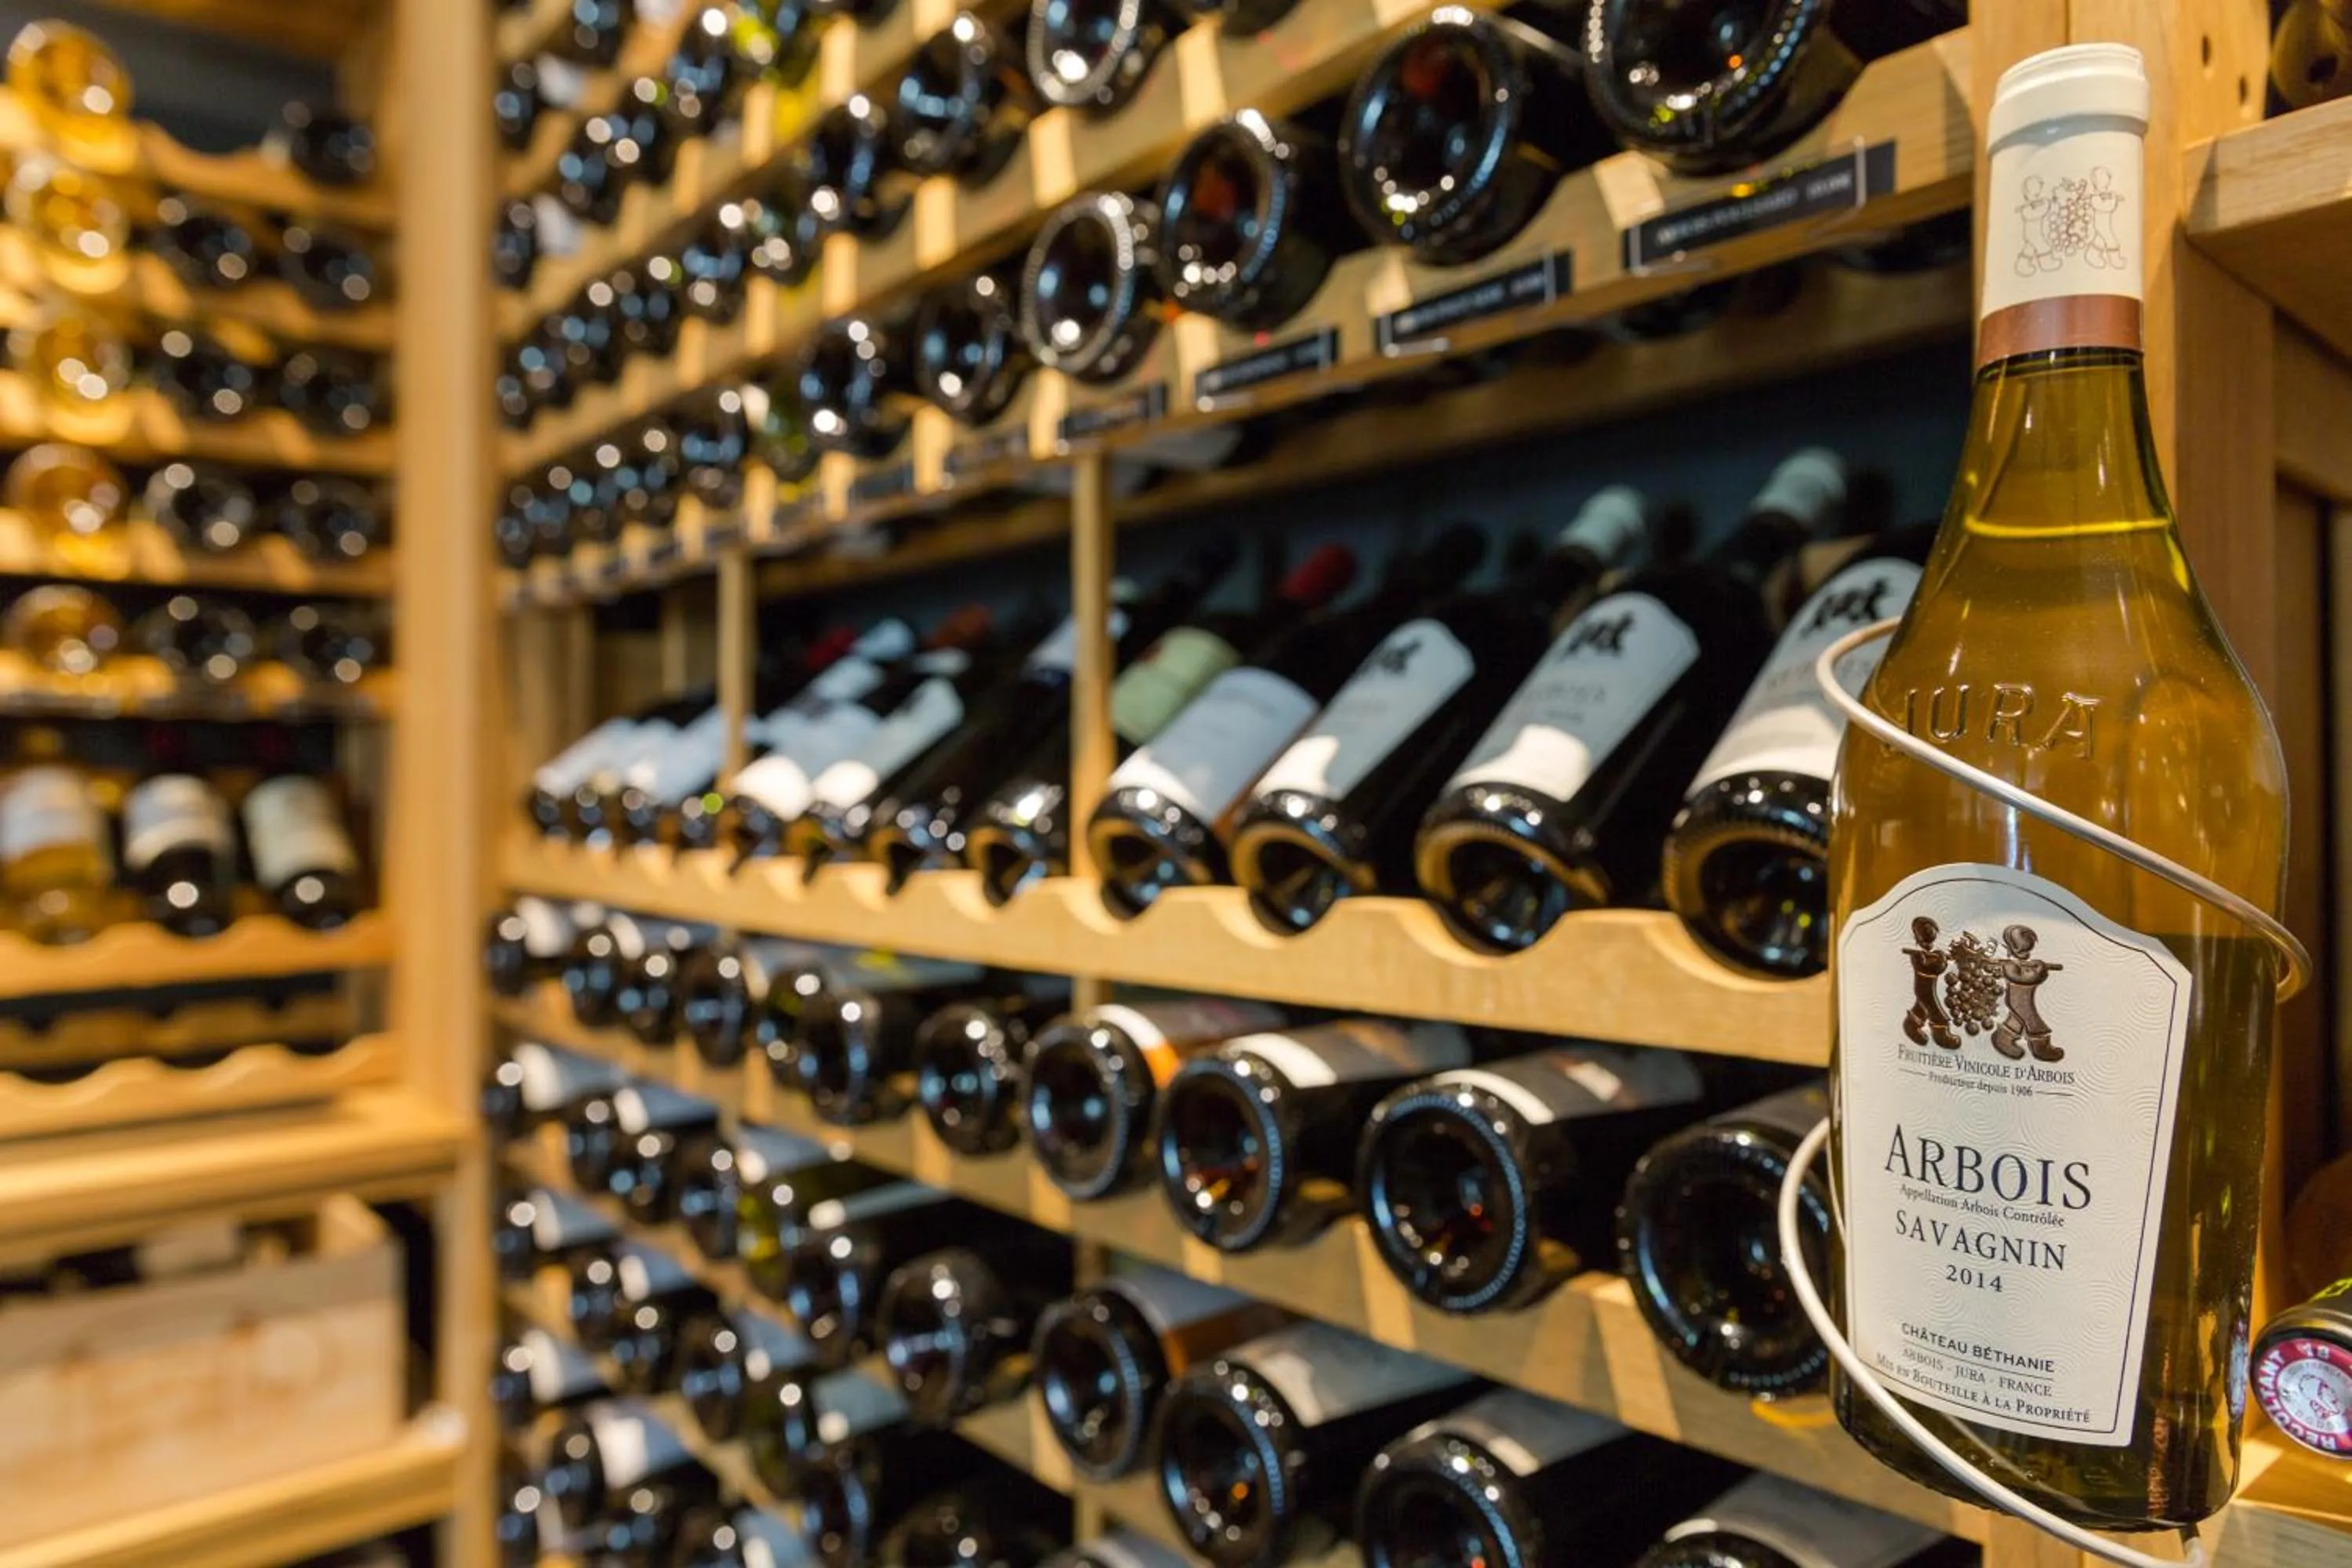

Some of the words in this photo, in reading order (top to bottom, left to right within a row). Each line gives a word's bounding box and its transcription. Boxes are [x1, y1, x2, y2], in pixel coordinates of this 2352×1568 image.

[1883, 683, 2101, 759] JURA
[1955, 1054, 2011, 1078] VINICOLE
[1976, 1080, 2008, 1094] depuis
[2011, 1085, 2033, 1096] 1906
[1884, 1123, 2092, 1210] ARBOIS
[1899, 1183, 1958, 1208] Appellation
[1961, 1198, 1999, 1218] Arbois
[2003, 1206, 2065, 1227] Contrôlée
[1895, 1210, 2067, 1271] SAVAGNIN
[1945, 1264, 2003, 1293] 2014
[1901, 1323, 1968, 1355] CHÂTEAU
[1972, 1344, 2056, 1374] BÉTHANIE
[1902, 1347, 1944, 1372] ARBOIS
[1954, 1365, 1986, 1382] JURA
[1998, 1376, 2053, 1397] FRANCE
[1911, 1368, 1978, 1403] BOUTEILLE
[1994, 1399, 2011, 1410] LA
[2016, 1398, 2091, 1423] PROPRIÉTÉ
